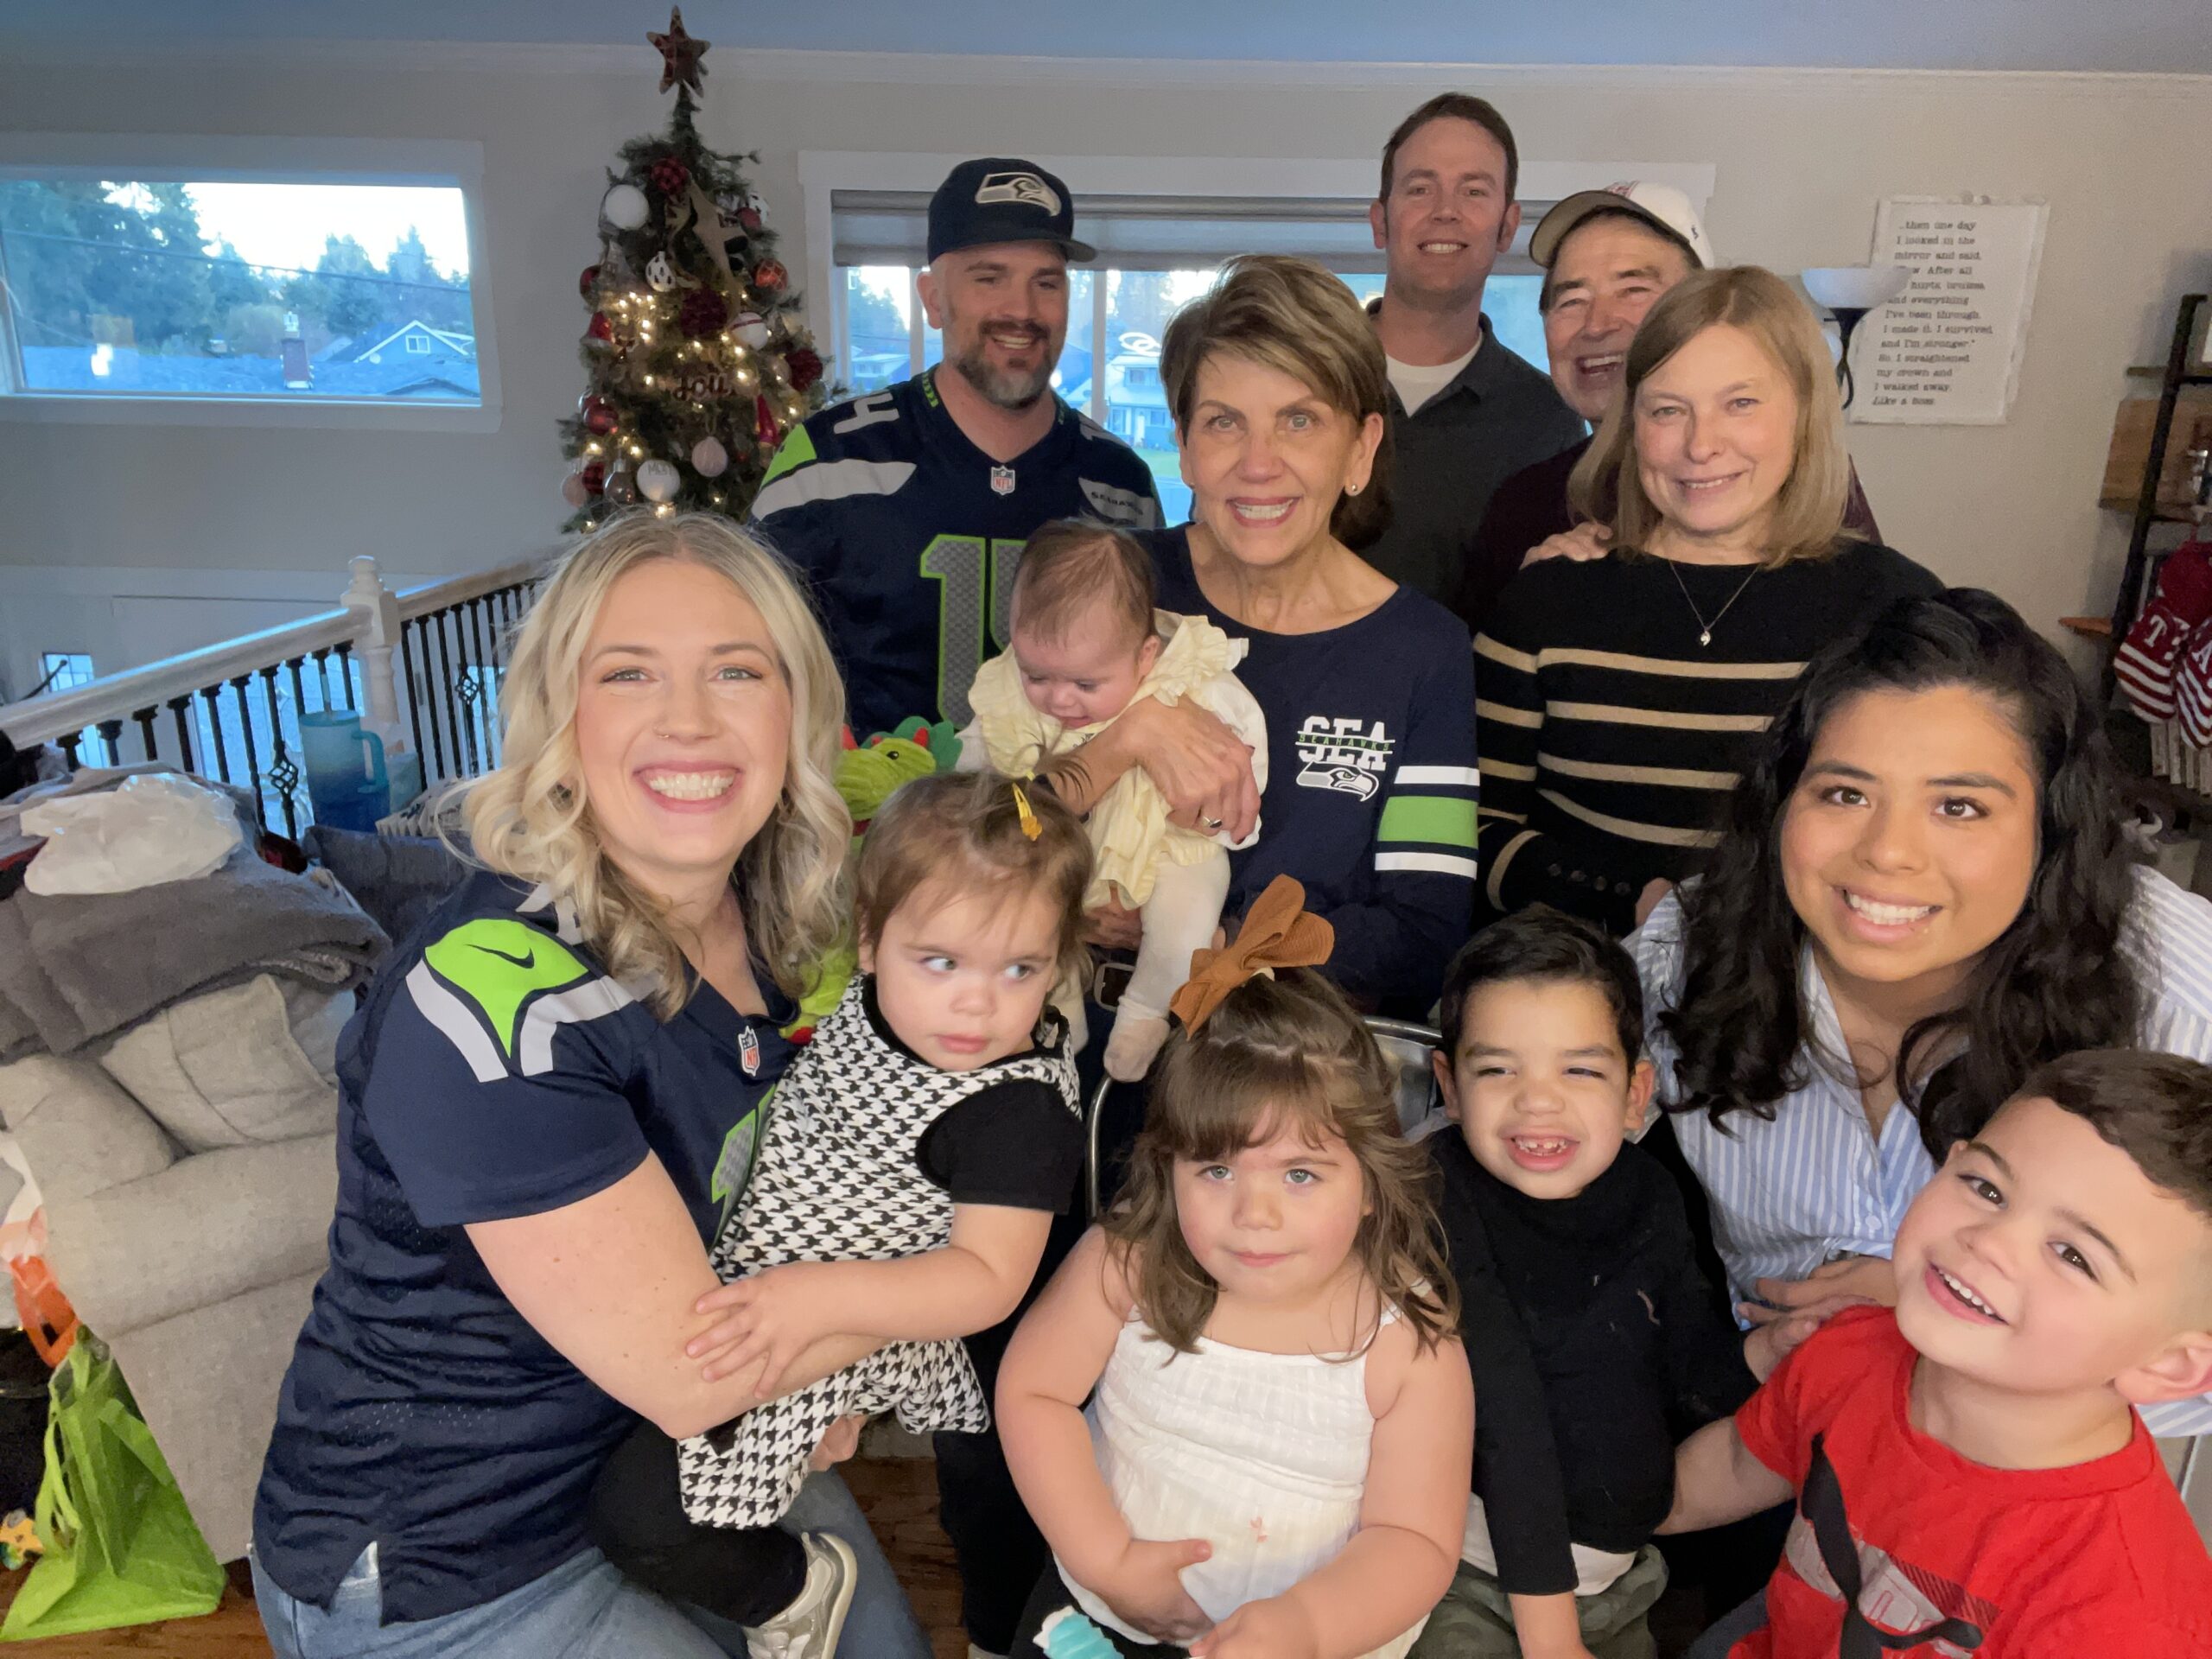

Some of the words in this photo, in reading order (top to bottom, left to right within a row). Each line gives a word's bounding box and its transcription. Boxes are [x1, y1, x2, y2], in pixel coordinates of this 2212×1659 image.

[1957, 221, 1977, 231] day
[1904, 235, 1939, 245] looked
[1958, 236, 1975, 245] the
[1894, 251, 1932, 260] mirror
[1959, 266, 1972, 275] all
[1911, 296, 1970, 305] everything
[1909, 310, 1932, 319] been
[1904, 354, 1970, 364] straightened
[1933, 368, 1953, 377] and
[1872, 397, 1897, 405] Like
[1298, 734, 1391, 752] SEAHAWKS
